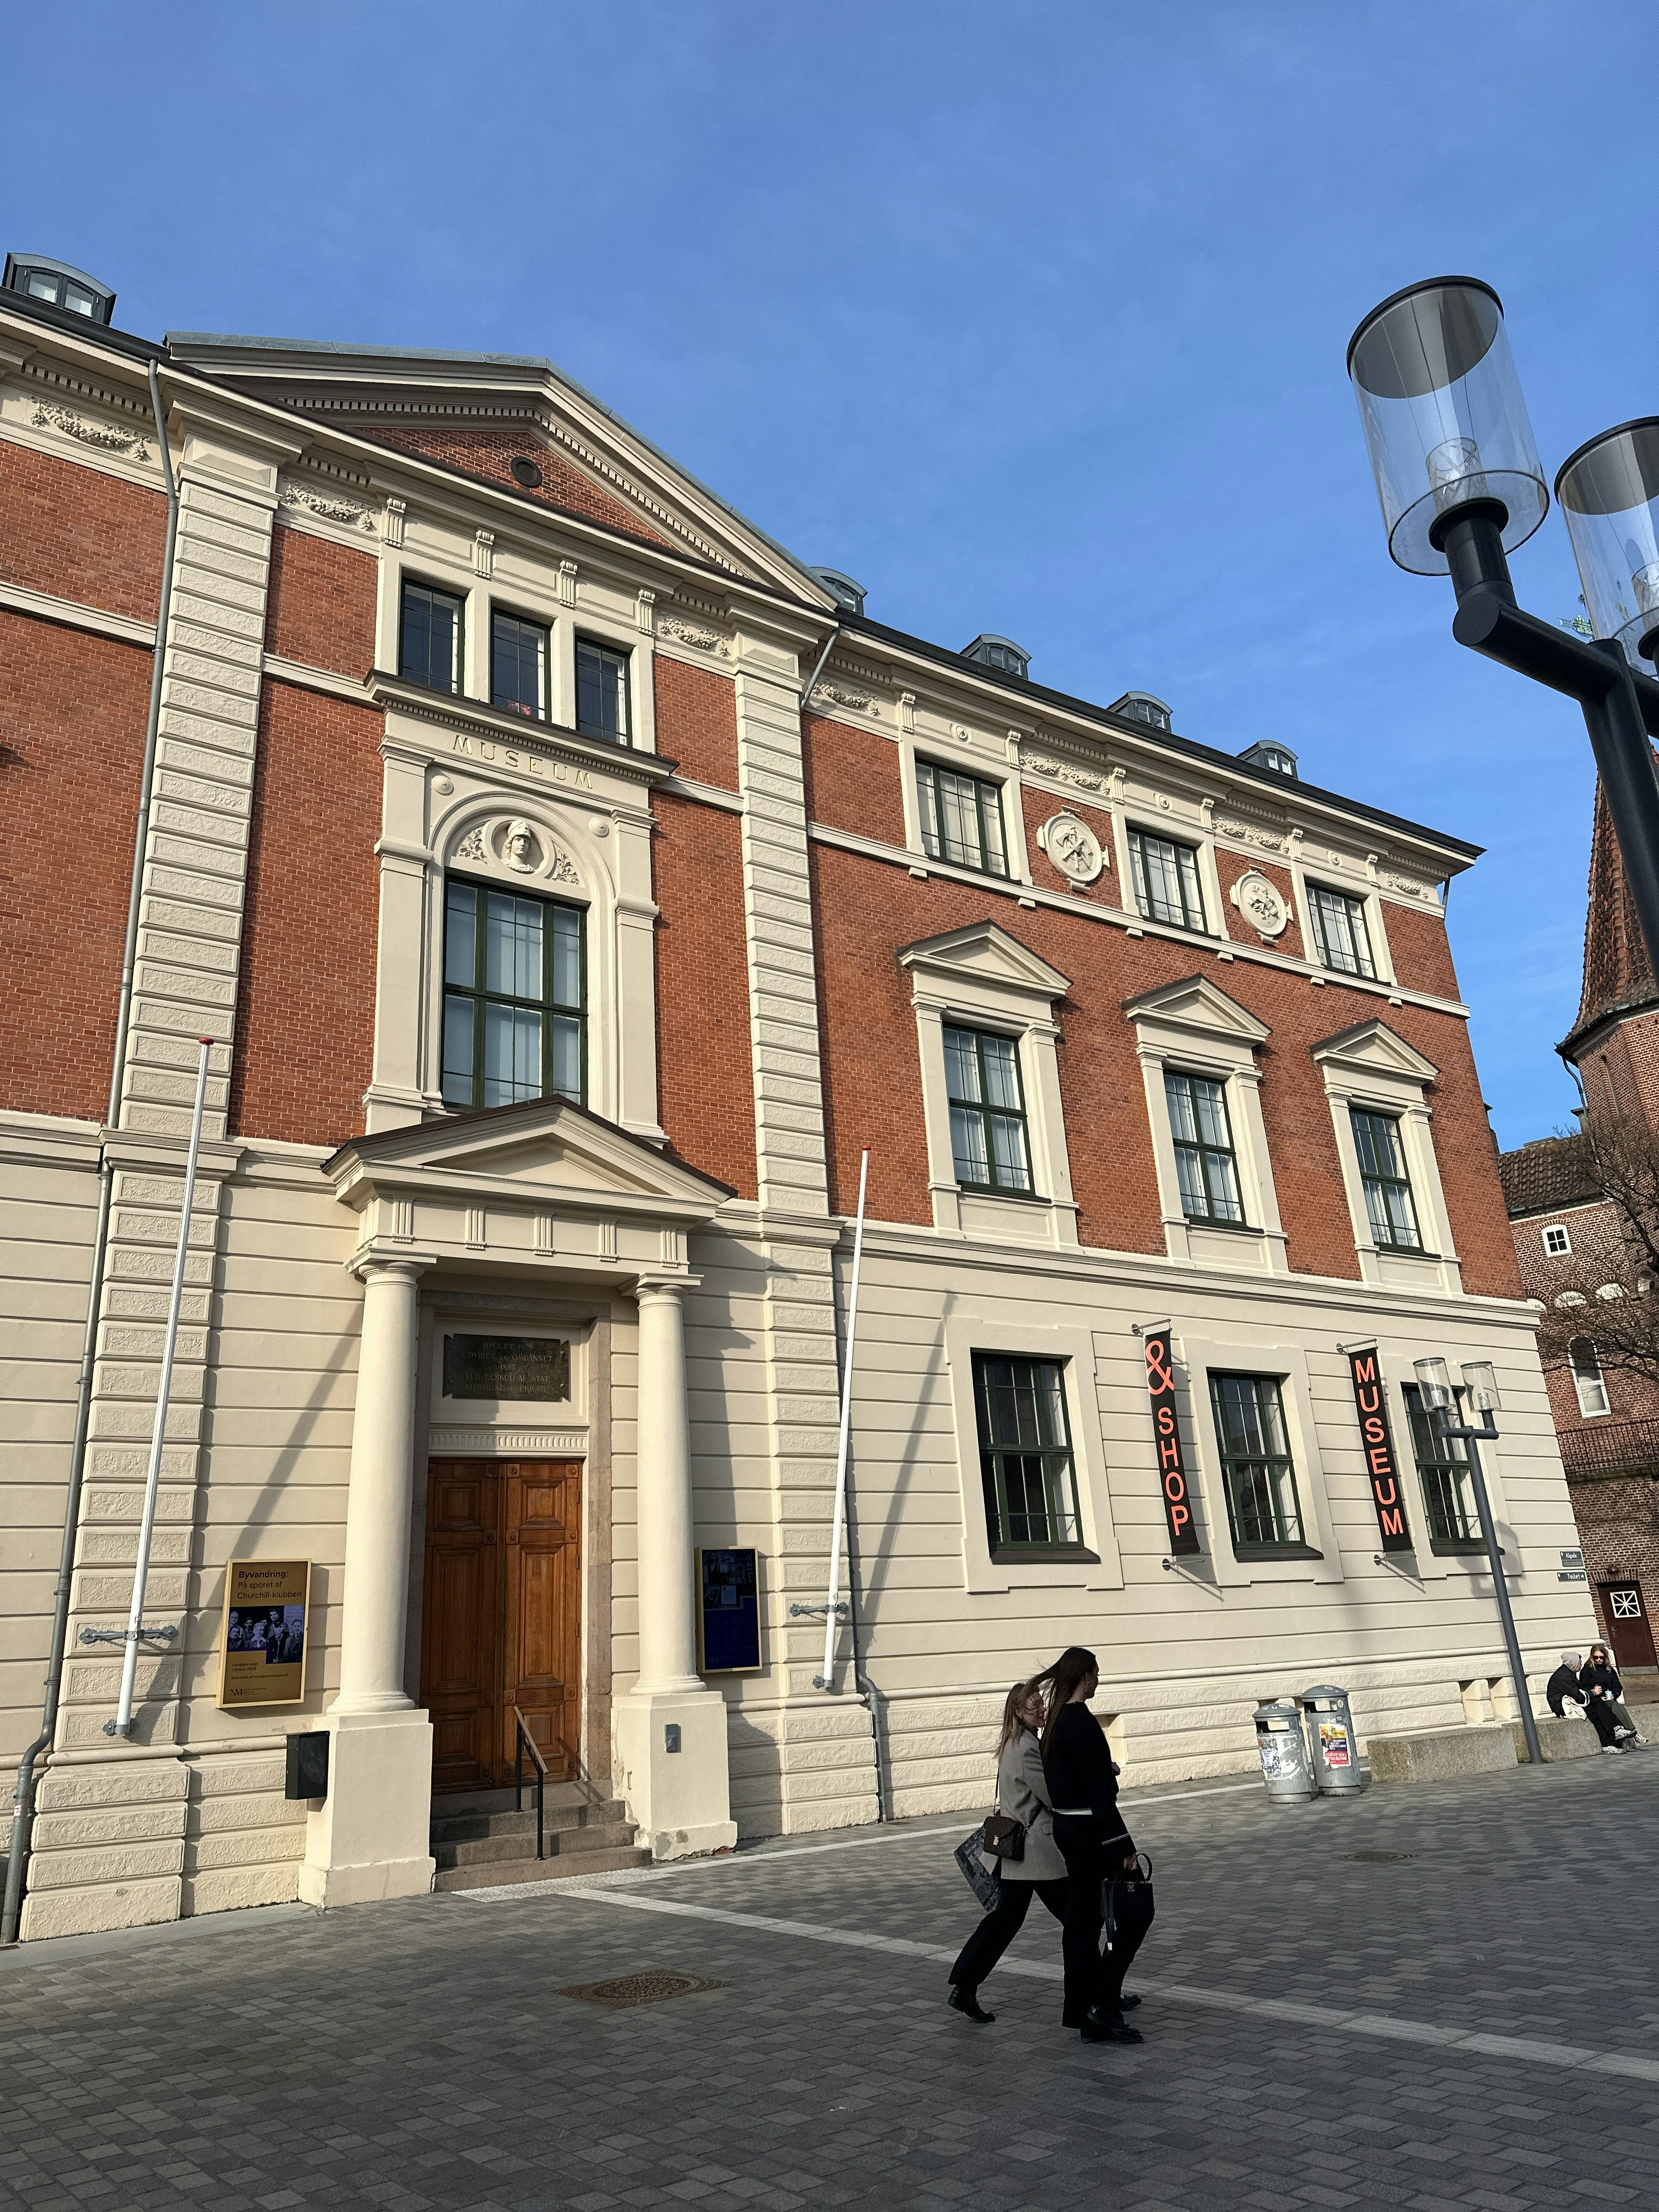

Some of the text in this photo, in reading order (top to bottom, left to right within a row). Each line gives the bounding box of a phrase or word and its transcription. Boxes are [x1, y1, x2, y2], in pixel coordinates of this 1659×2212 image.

[453, 735, 593, 789] MUSEUM
[512, 1354, 552, 1362] OMDANNET
[1146, 1340, 1189, 1536] & SHOP
[1355, 1356, 1404, 1536] MUSEUM
[239, 1570, 288, 1579] Byvandring:
[238, 1581, 247, 1589] På
[249, 1581, 273, 1589] sporet
[237, 1591, 302, 1599] Churchill-klubben
